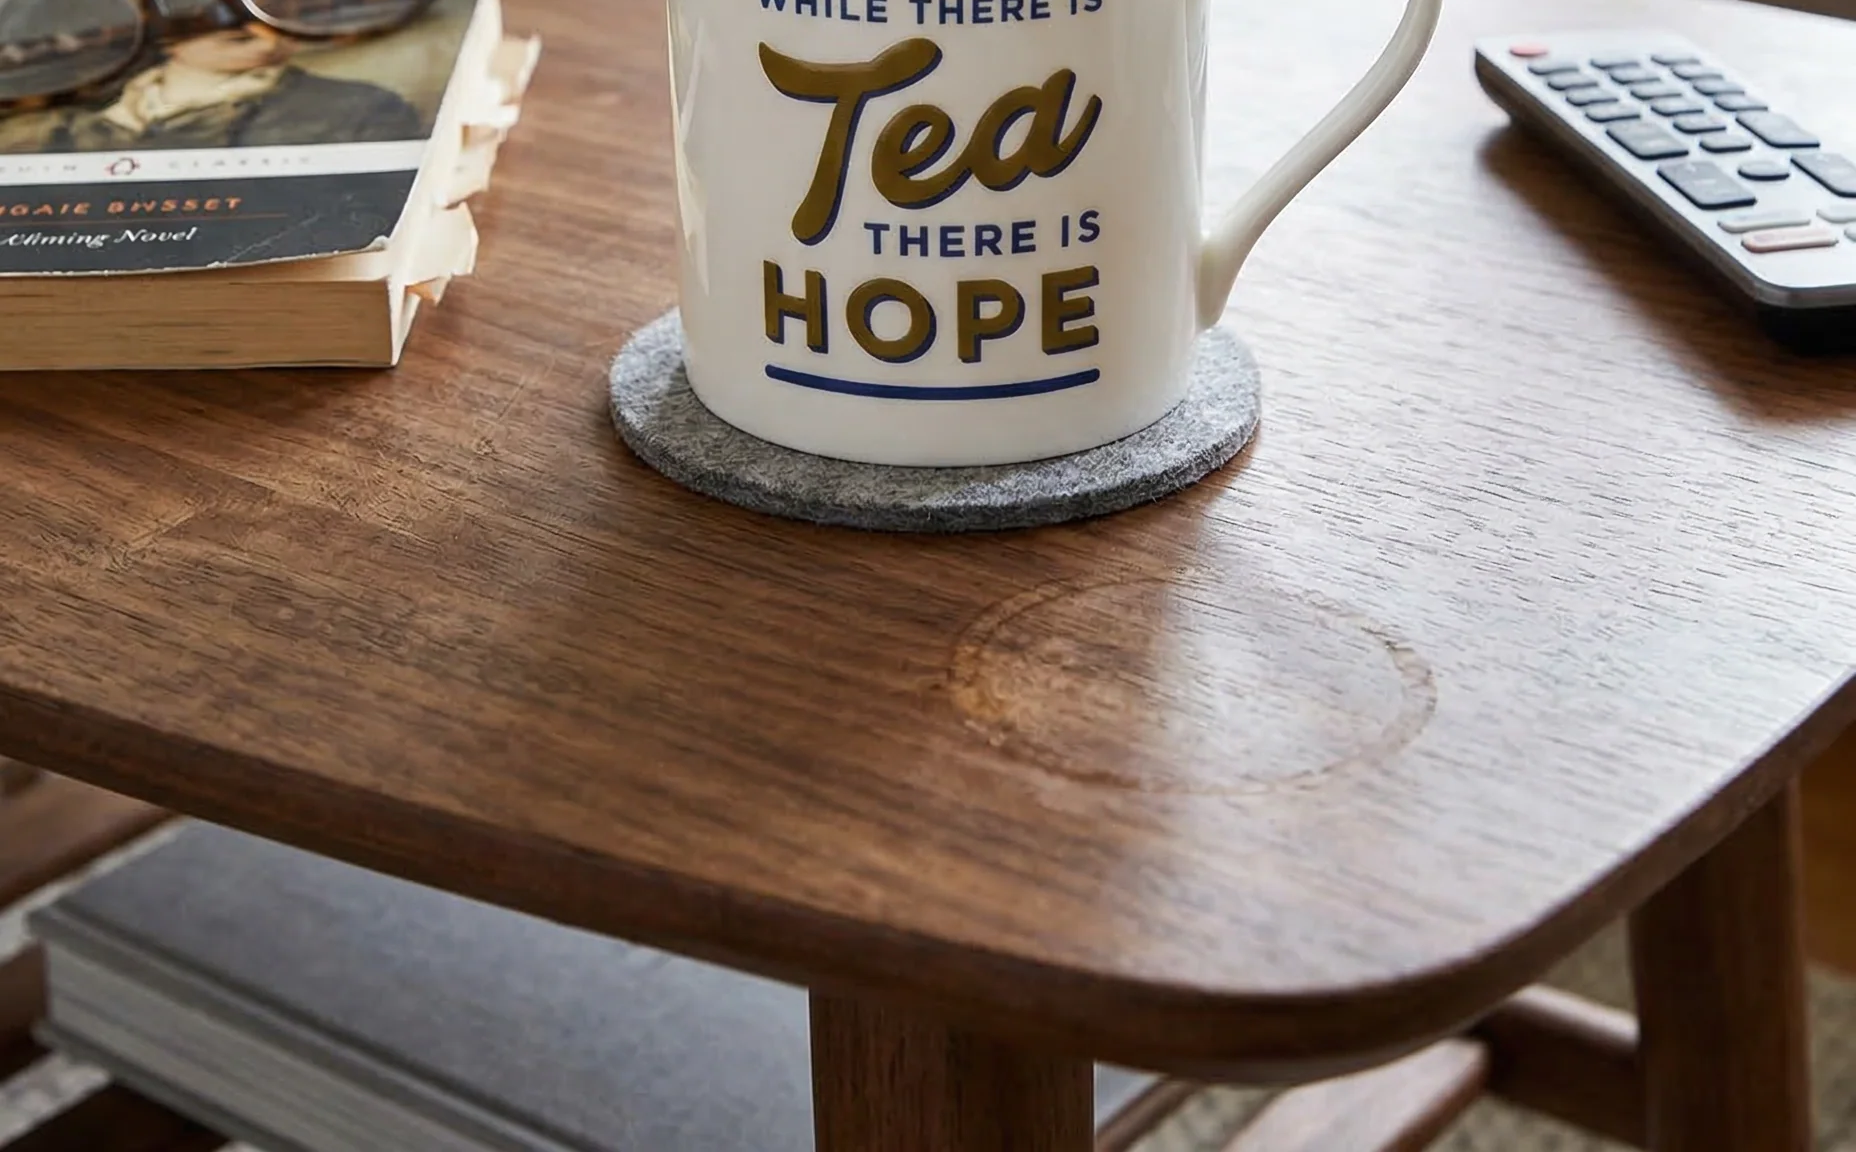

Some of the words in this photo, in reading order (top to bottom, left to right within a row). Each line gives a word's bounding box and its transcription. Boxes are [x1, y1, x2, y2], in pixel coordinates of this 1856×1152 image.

[758, 37, 1104, 247] Tea
[113, 226, 198, 244] Novel
[864, 219, 1036, 258] THERE
[1060, 209, 1101, 248] IS
[763, 259, 1101, 365] HOPE
